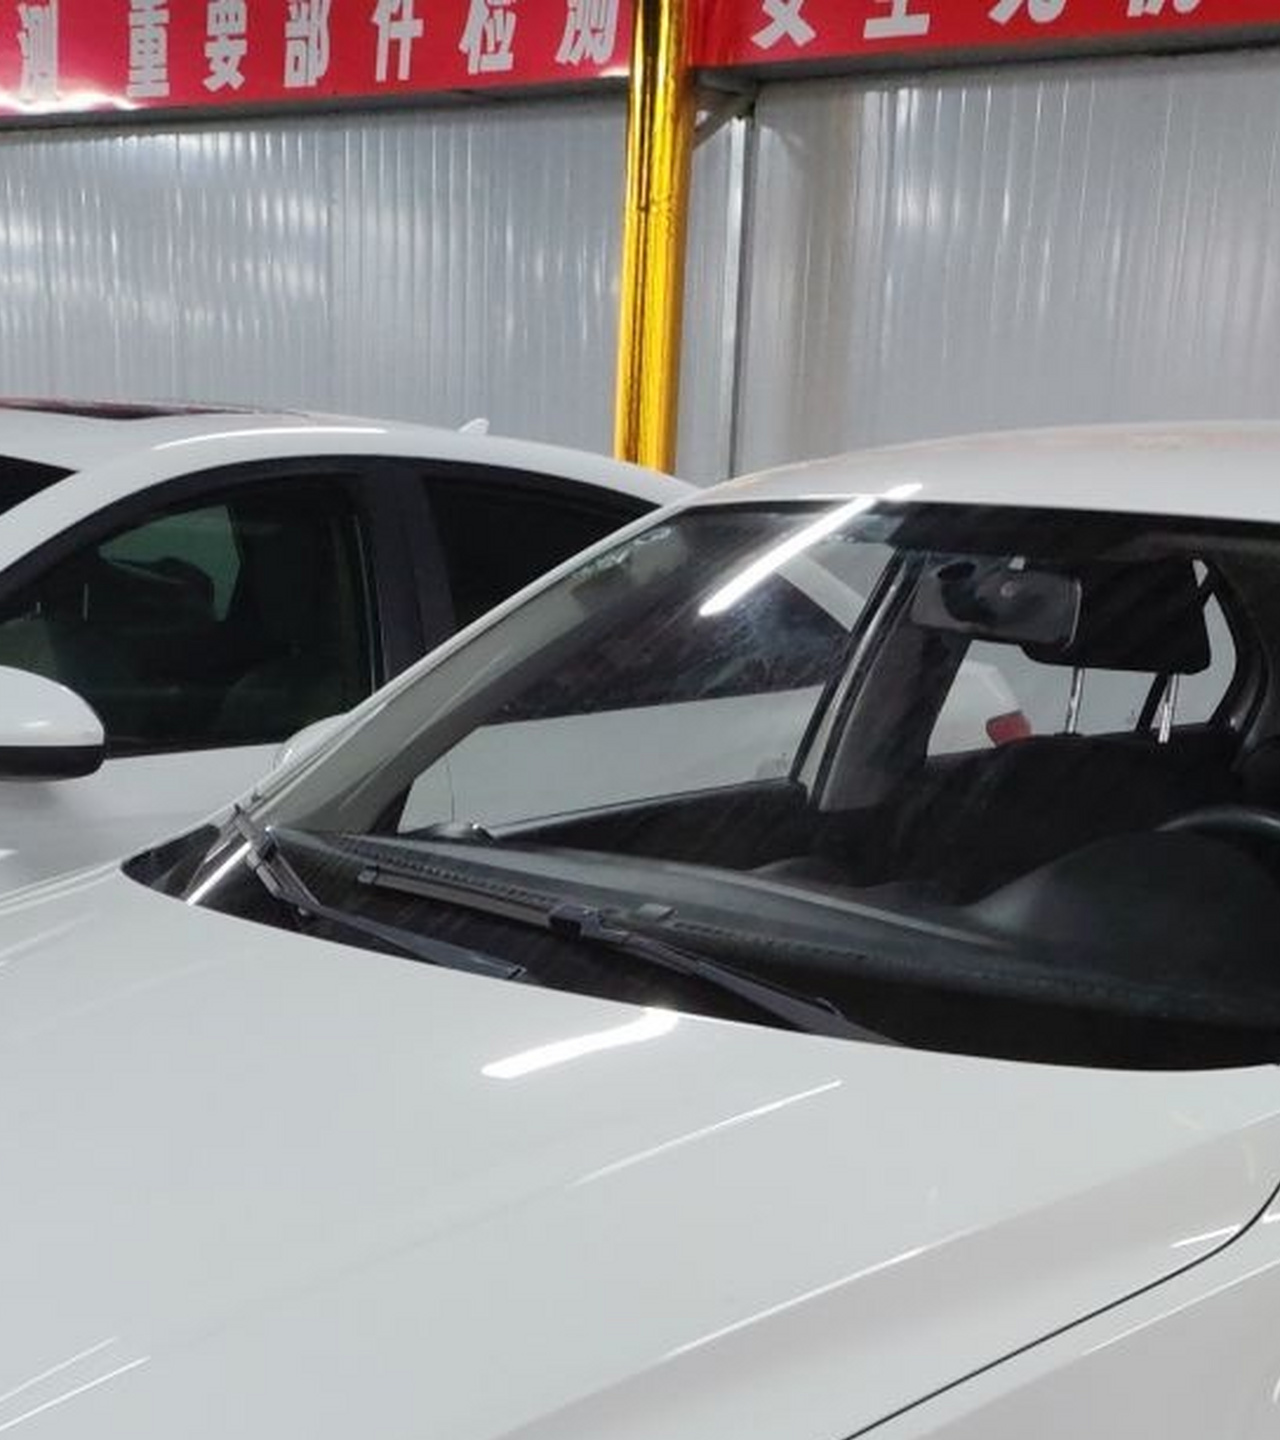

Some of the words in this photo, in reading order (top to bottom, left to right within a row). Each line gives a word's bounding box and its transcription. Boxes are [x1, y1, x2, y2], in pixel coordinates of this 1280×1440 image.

[125, 0, 620, 98] 重要部件检测
